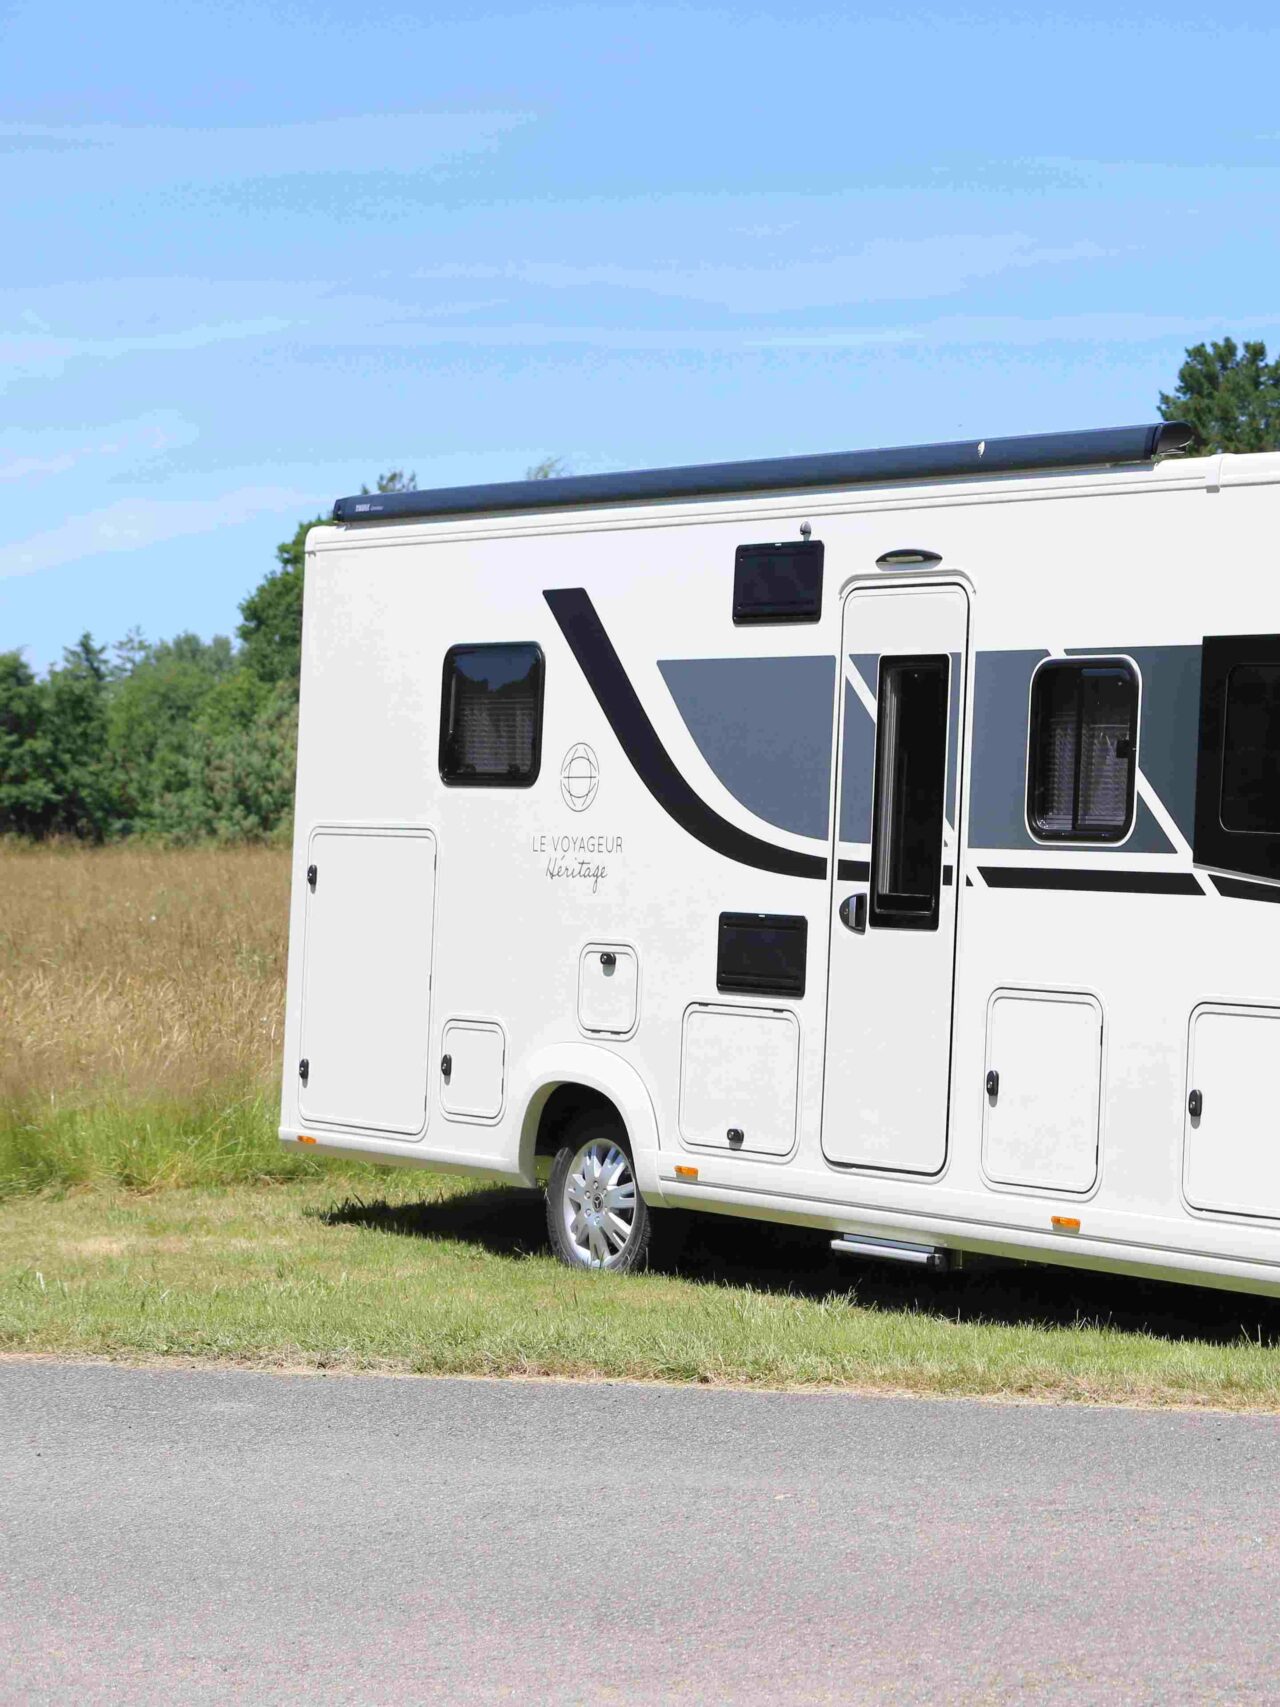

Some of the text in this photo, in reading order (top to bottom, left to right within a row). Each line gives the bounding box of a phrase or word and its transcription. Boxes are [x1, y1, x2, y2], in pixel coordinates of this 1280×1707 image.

[532, 835, 624, 854] LE VOYAGEUR
[545, 854, 609, 894] Héritage
